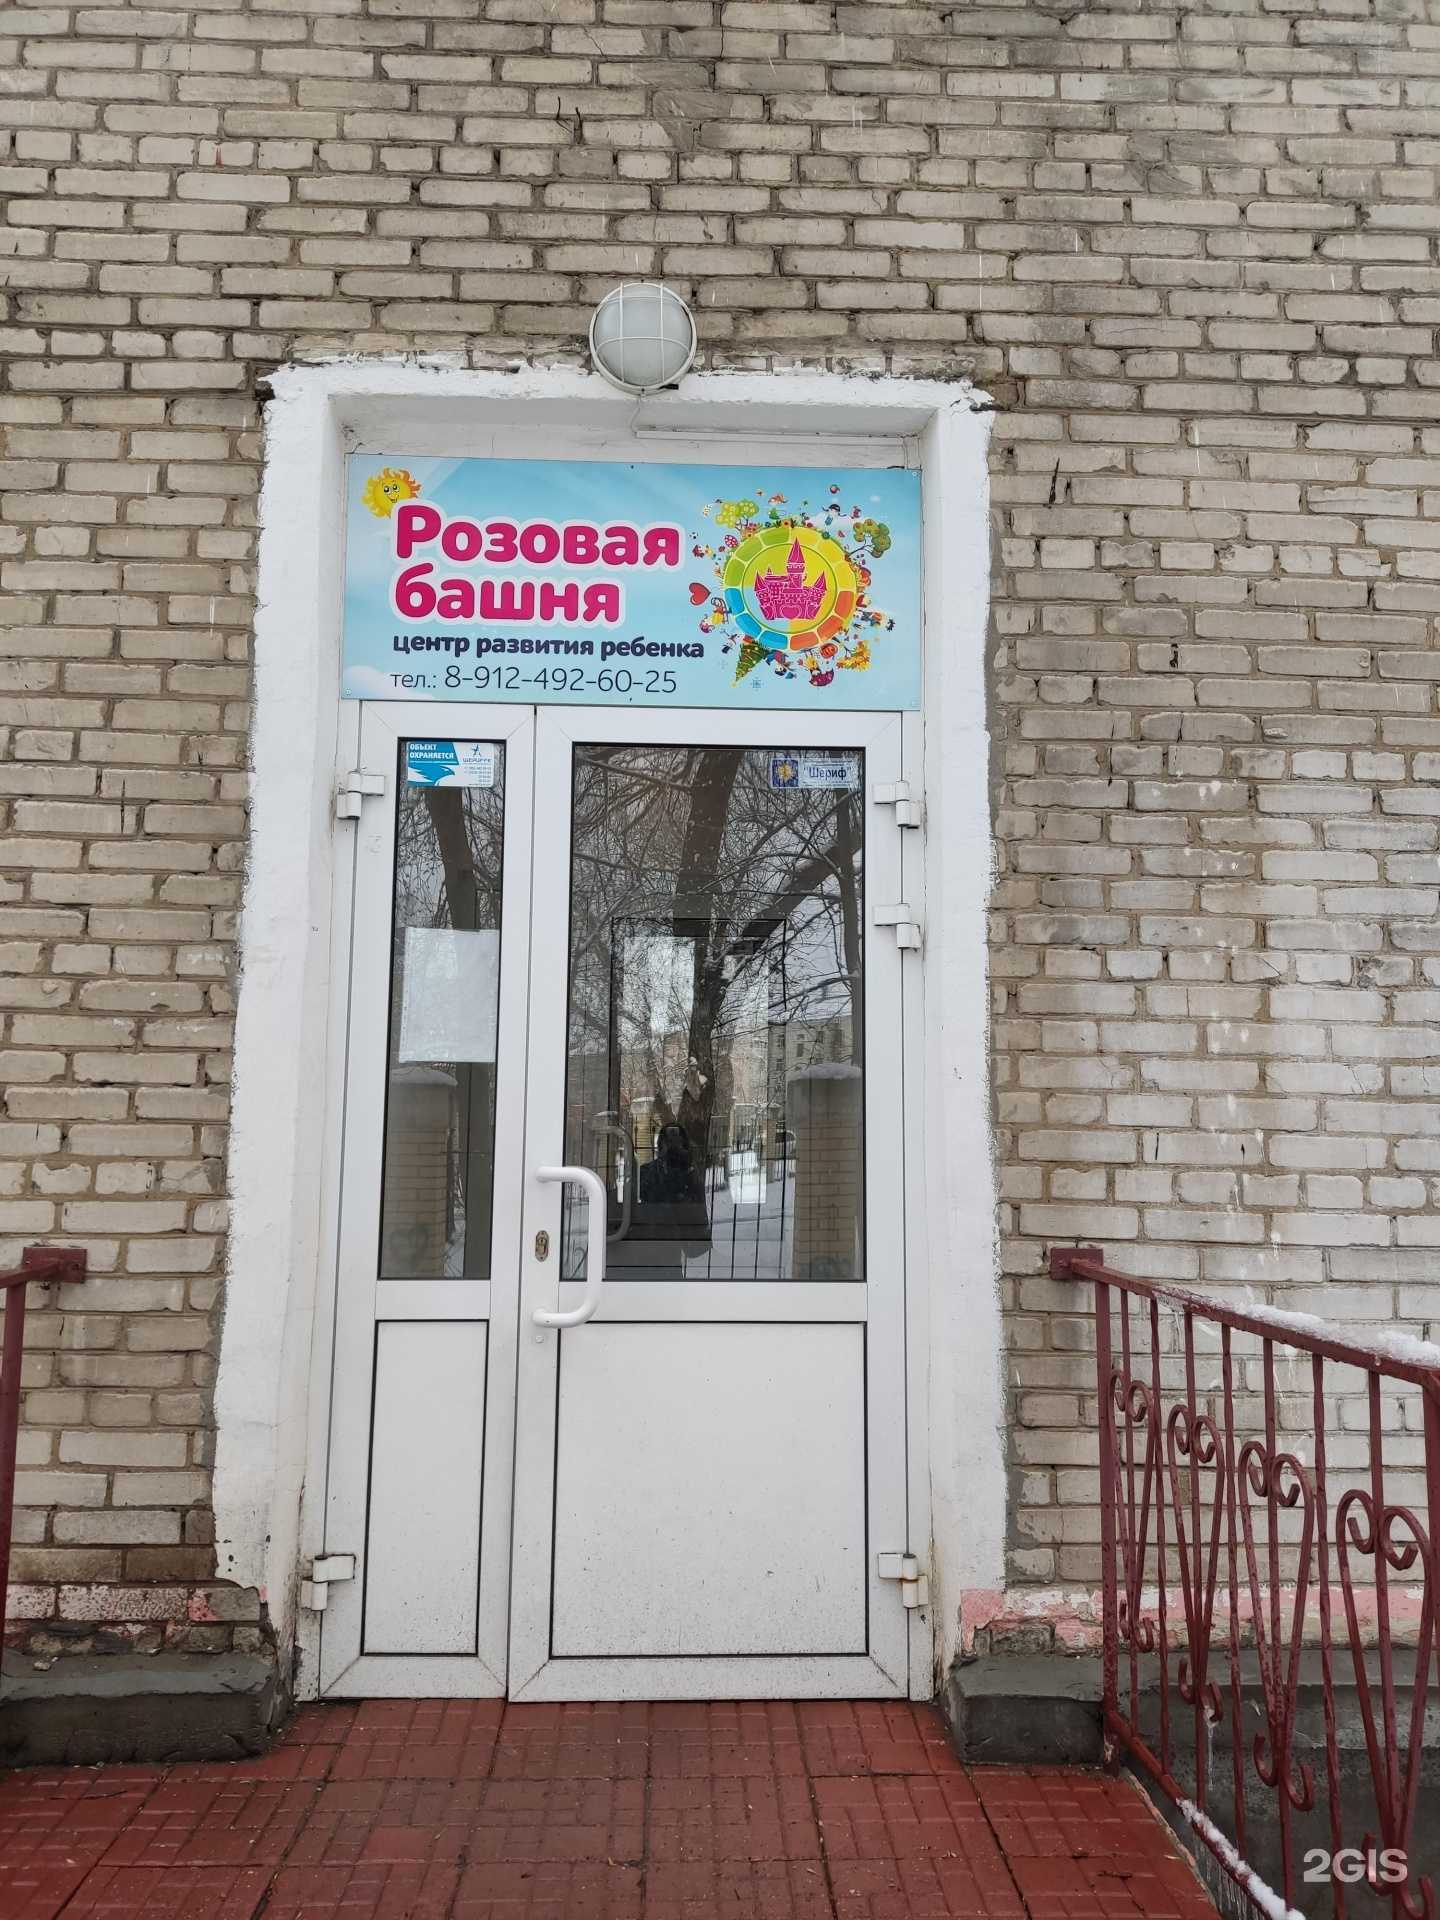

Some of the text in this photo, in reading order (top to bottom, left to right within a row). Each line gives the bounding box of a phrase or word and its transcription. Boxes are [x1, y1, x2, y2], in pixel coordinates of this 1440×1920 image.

[395, 503, 681, 567] Розовая
[394, 562, 621, 624] башня
[393, 635, 705, 661] центр развития ребенка
[390, 664, 678, 694] тел.: 8-912-492-60-25
[409, 743, 437, 751] ОБЪЕКТ
[409, 752, 454, 760] ОХРАНЯЕТСЯ
